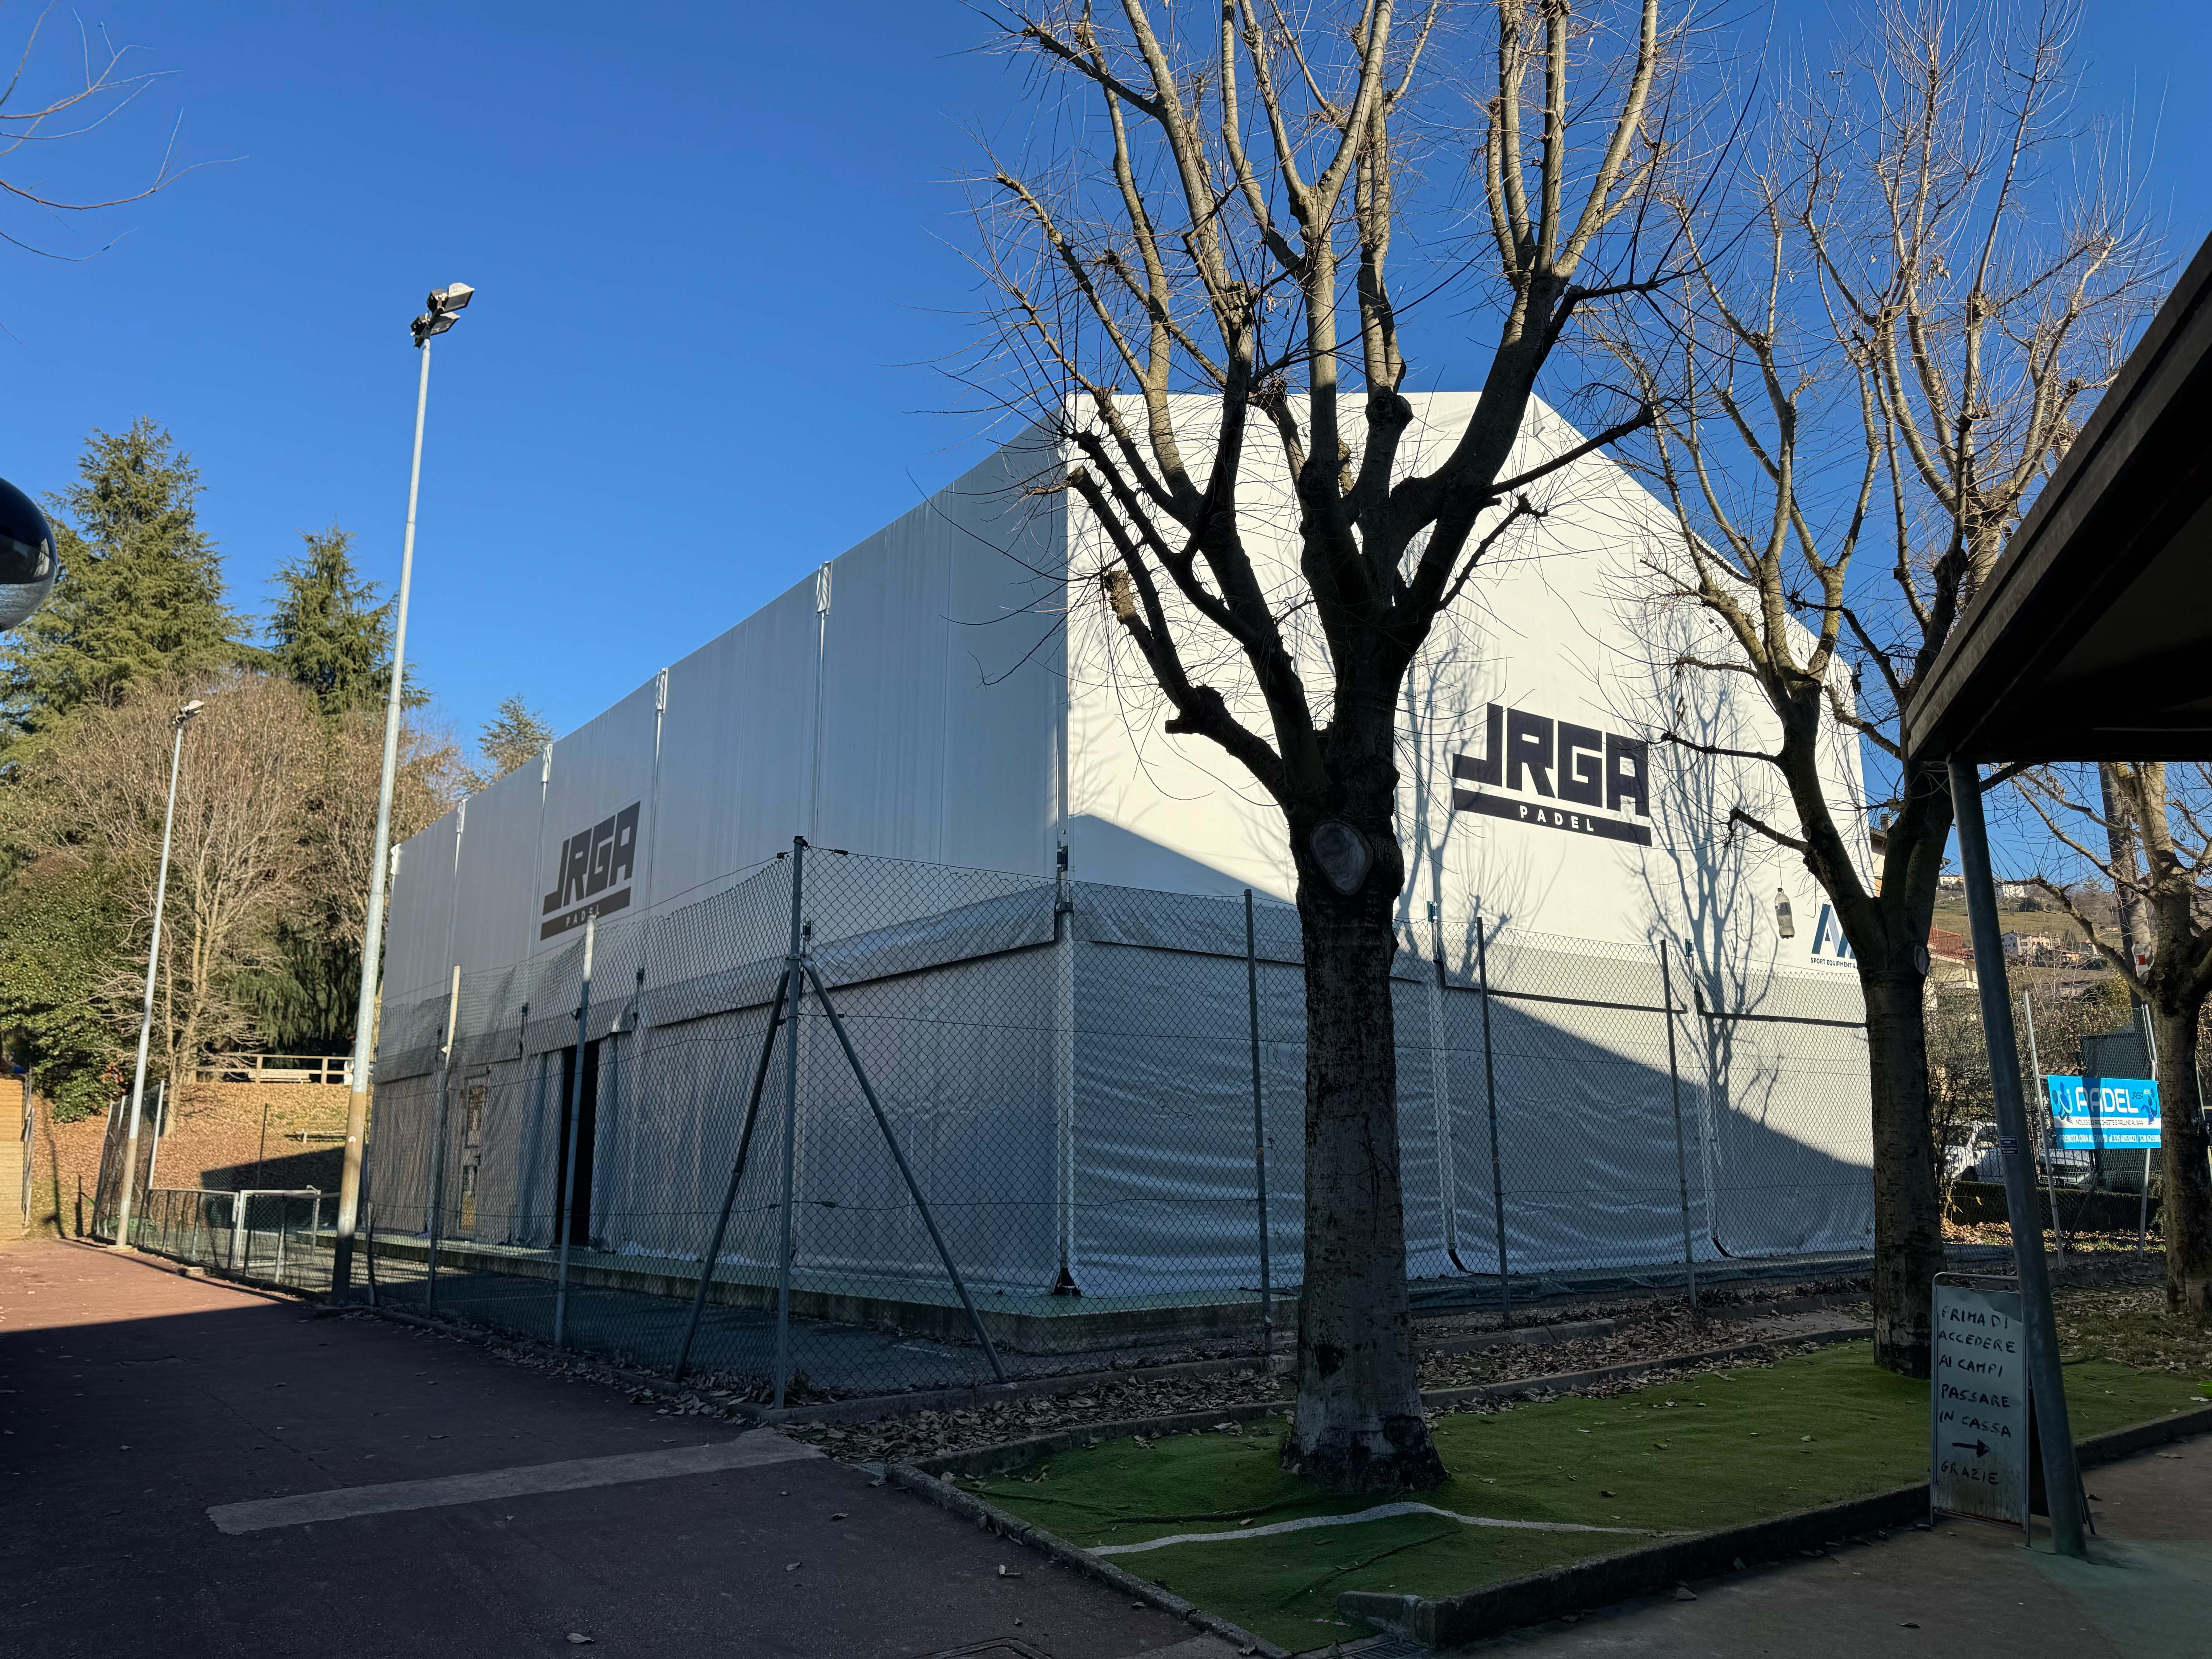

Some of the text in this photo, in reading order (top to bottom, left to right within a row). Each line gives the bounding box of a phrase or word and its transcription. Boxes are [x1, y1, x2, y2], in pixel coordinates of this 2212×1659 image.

[1452, 702, 1650, 818] JRGA
[1519, 805, 1594, 832] PADEL
[542, 800, 641, 915] JRGA
[1827, 960, 1852, 969] EQUIPMENT
[2075, 1087, 2139, 1113] PADEL
[2131, 1091, 2143, 1099] JRGA
[2059, 1134, 2079, 1142] PRENOTA
[2079, 1134, 2088, 1143] ORA
[1991, 1314, 2008, 1329] DI
[1939, 1330, 2016, 1353] ACCEDERE
[1939, 1354, 2003, 1377] AI CAMPI
[1941, 1383, 2010, 1408] PASSARE
[1939, 1410, 2011, 1438] IN CASSA
[1941, 1460, 1999, 1485] GRAZIE
